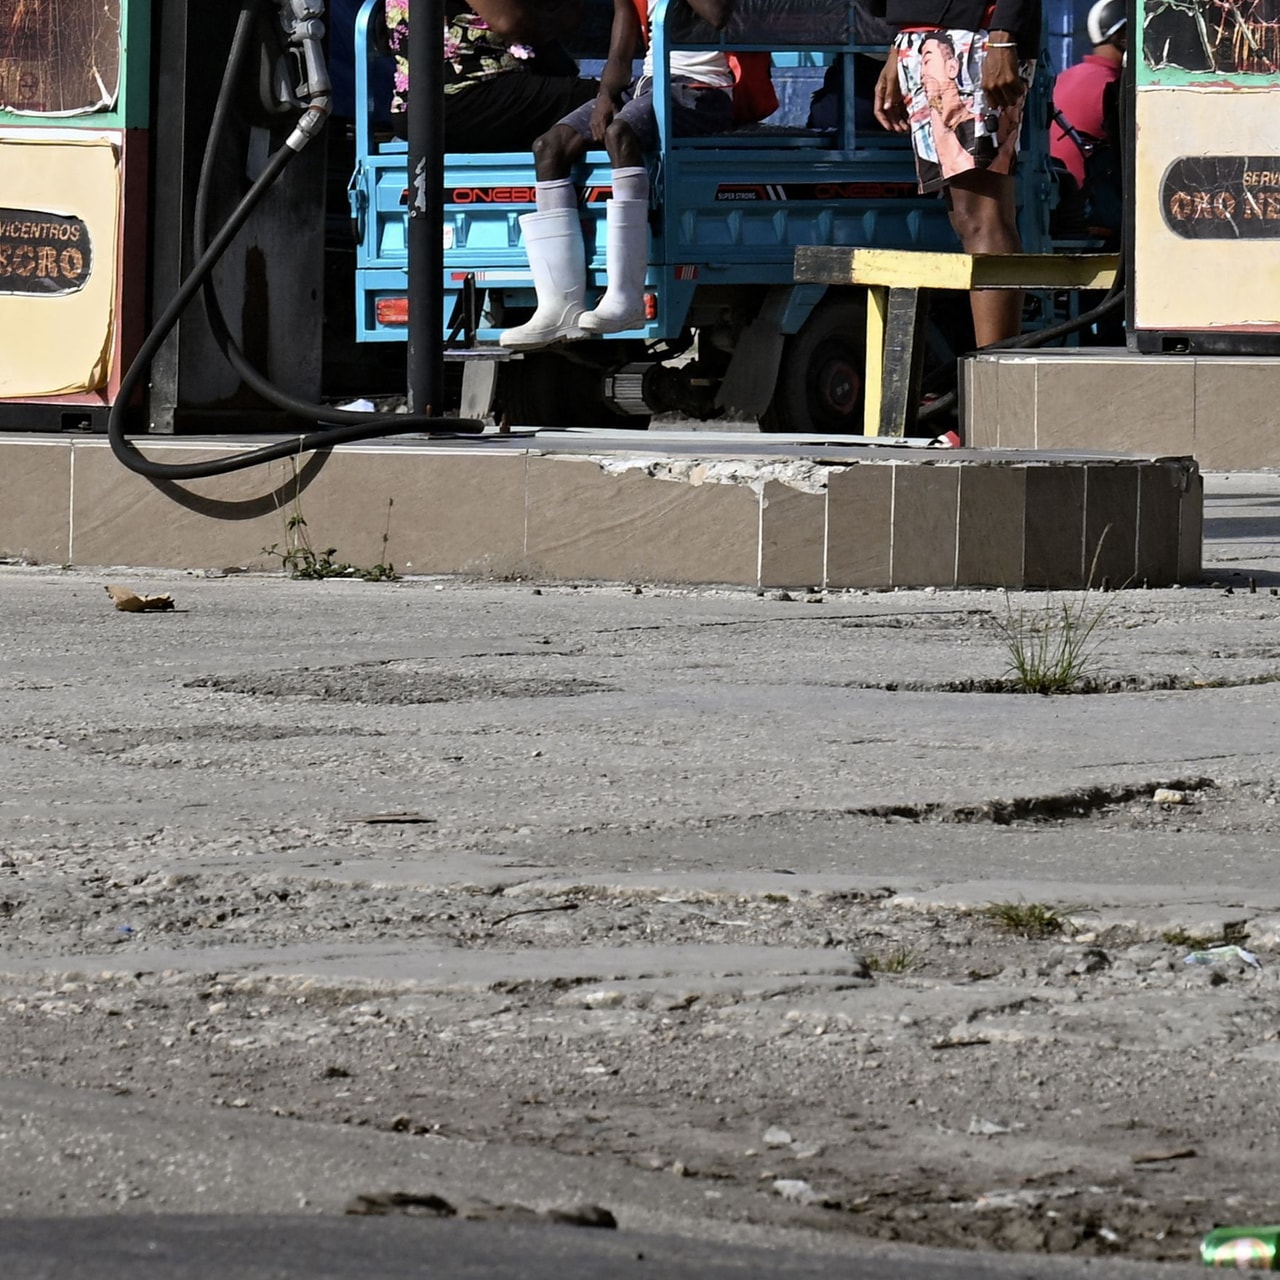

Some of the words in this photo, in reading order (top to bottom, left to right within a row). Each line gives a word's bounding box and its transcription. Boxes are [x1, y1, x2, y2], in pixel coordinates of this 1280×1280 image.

[453, 187, 537, 203] ONEB
[736, 192, 756, 200] STRONG
[1170, 191, 1236, 221] ORO
